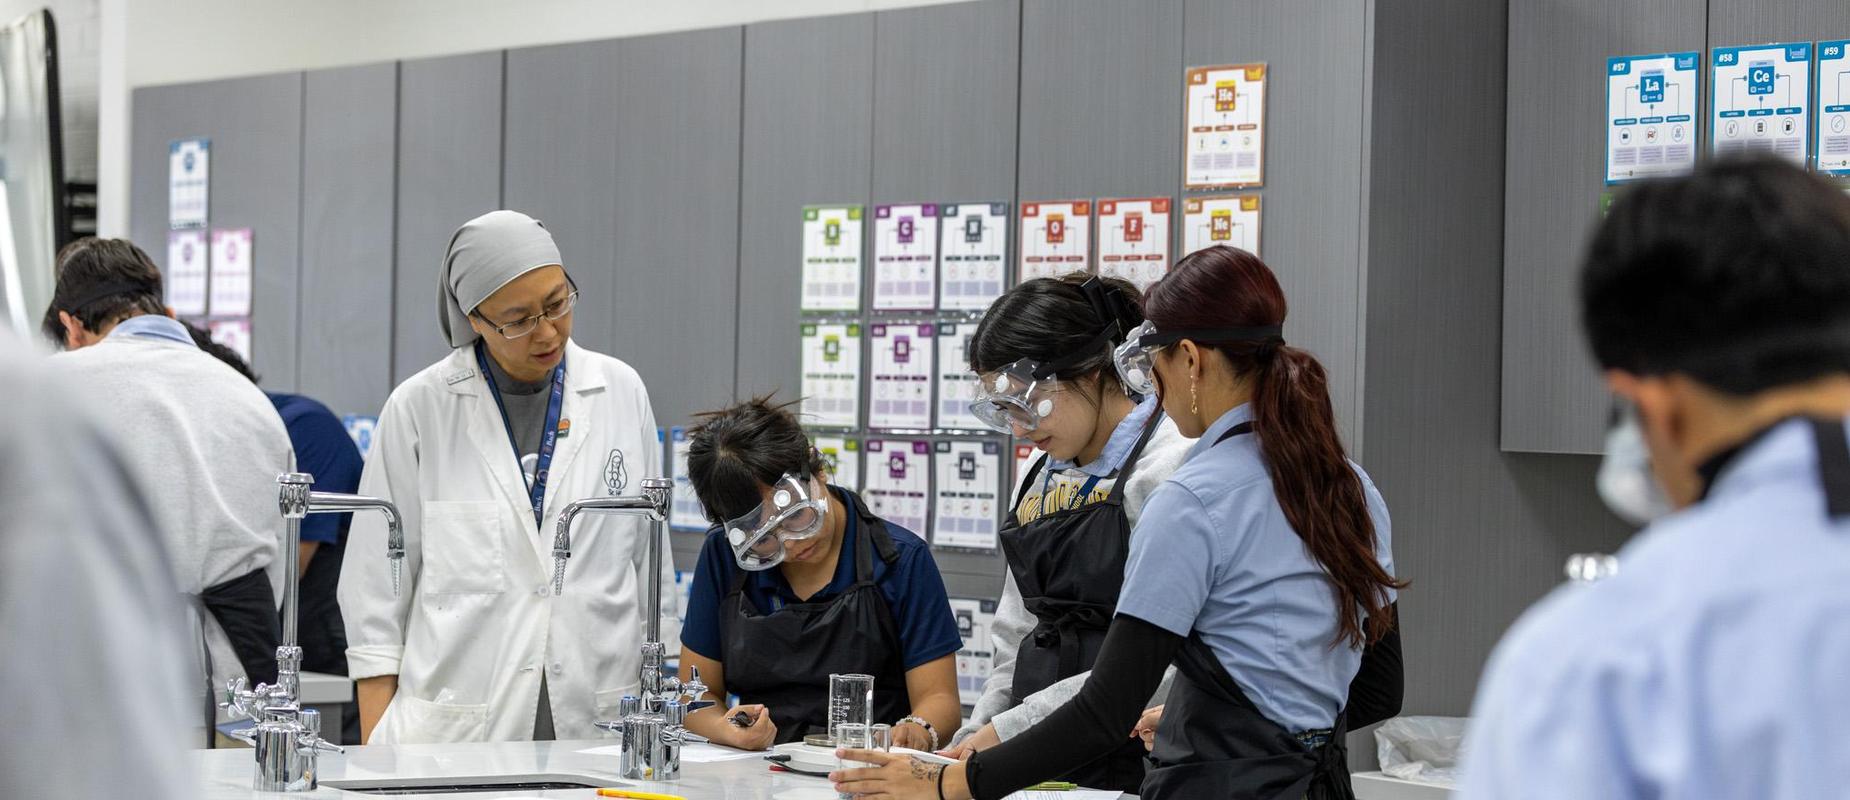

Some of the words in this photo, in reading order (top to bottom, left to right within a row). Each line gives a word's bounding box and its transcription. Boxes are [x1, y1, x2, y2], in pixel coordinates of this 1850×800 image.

[1718, 53, 1733, 62] #58
[1823, 46, 1839, 56] #59
[1612, 62, 1626, 71] #57
[1753, 70, 1770, 83] Ce
[1645, 79, 1660, 92] La
[901, 222, 910, 235] C
[1051, 221, 1060, 234] O
[1130, 219, 1138, 233] F
